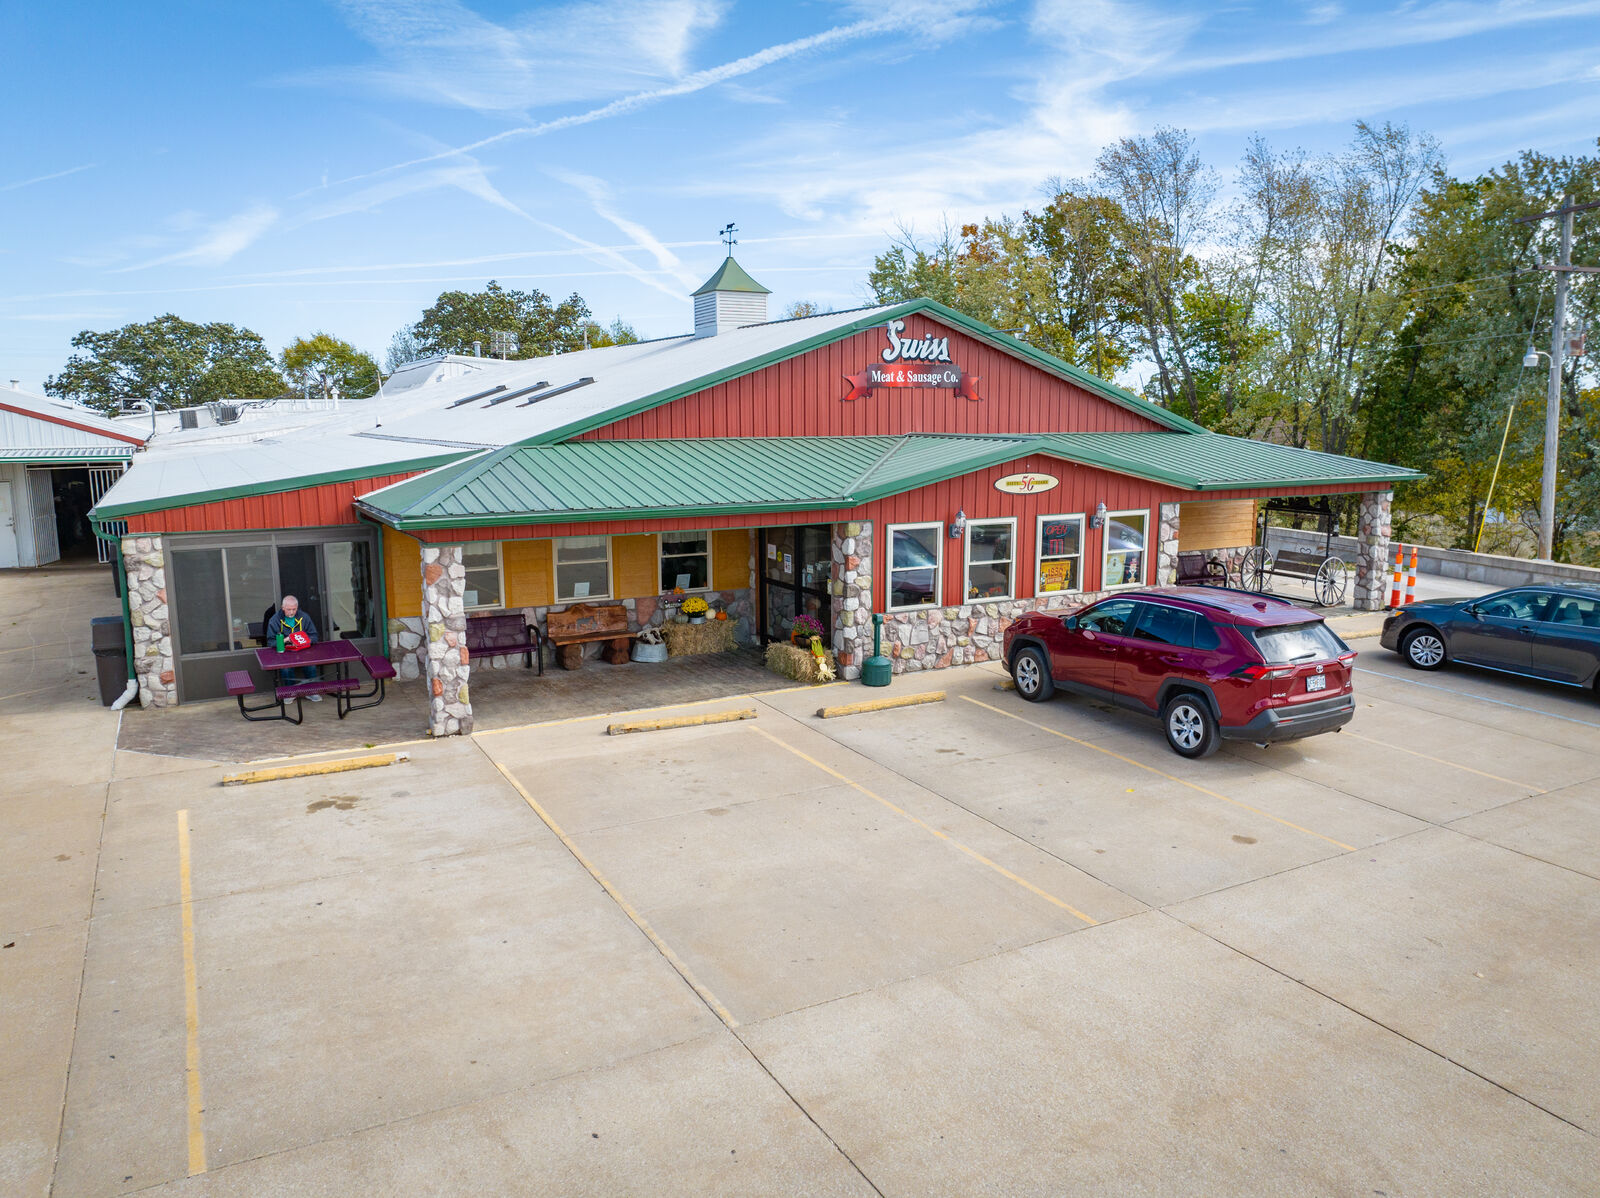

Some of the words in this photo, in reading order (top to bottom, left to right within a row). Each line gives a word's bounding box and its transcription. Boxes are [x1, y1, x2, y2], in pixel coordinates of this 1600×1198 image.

[882, 320, 952, 363] Swiss
[871, 370, 895, 383] Meat
[896, 370, 905, 383] &
[907, 370, 942, 386] Sausage
[943, 371, 959, 383] Co.
[1046, 524, 1068, 535] OPEN
